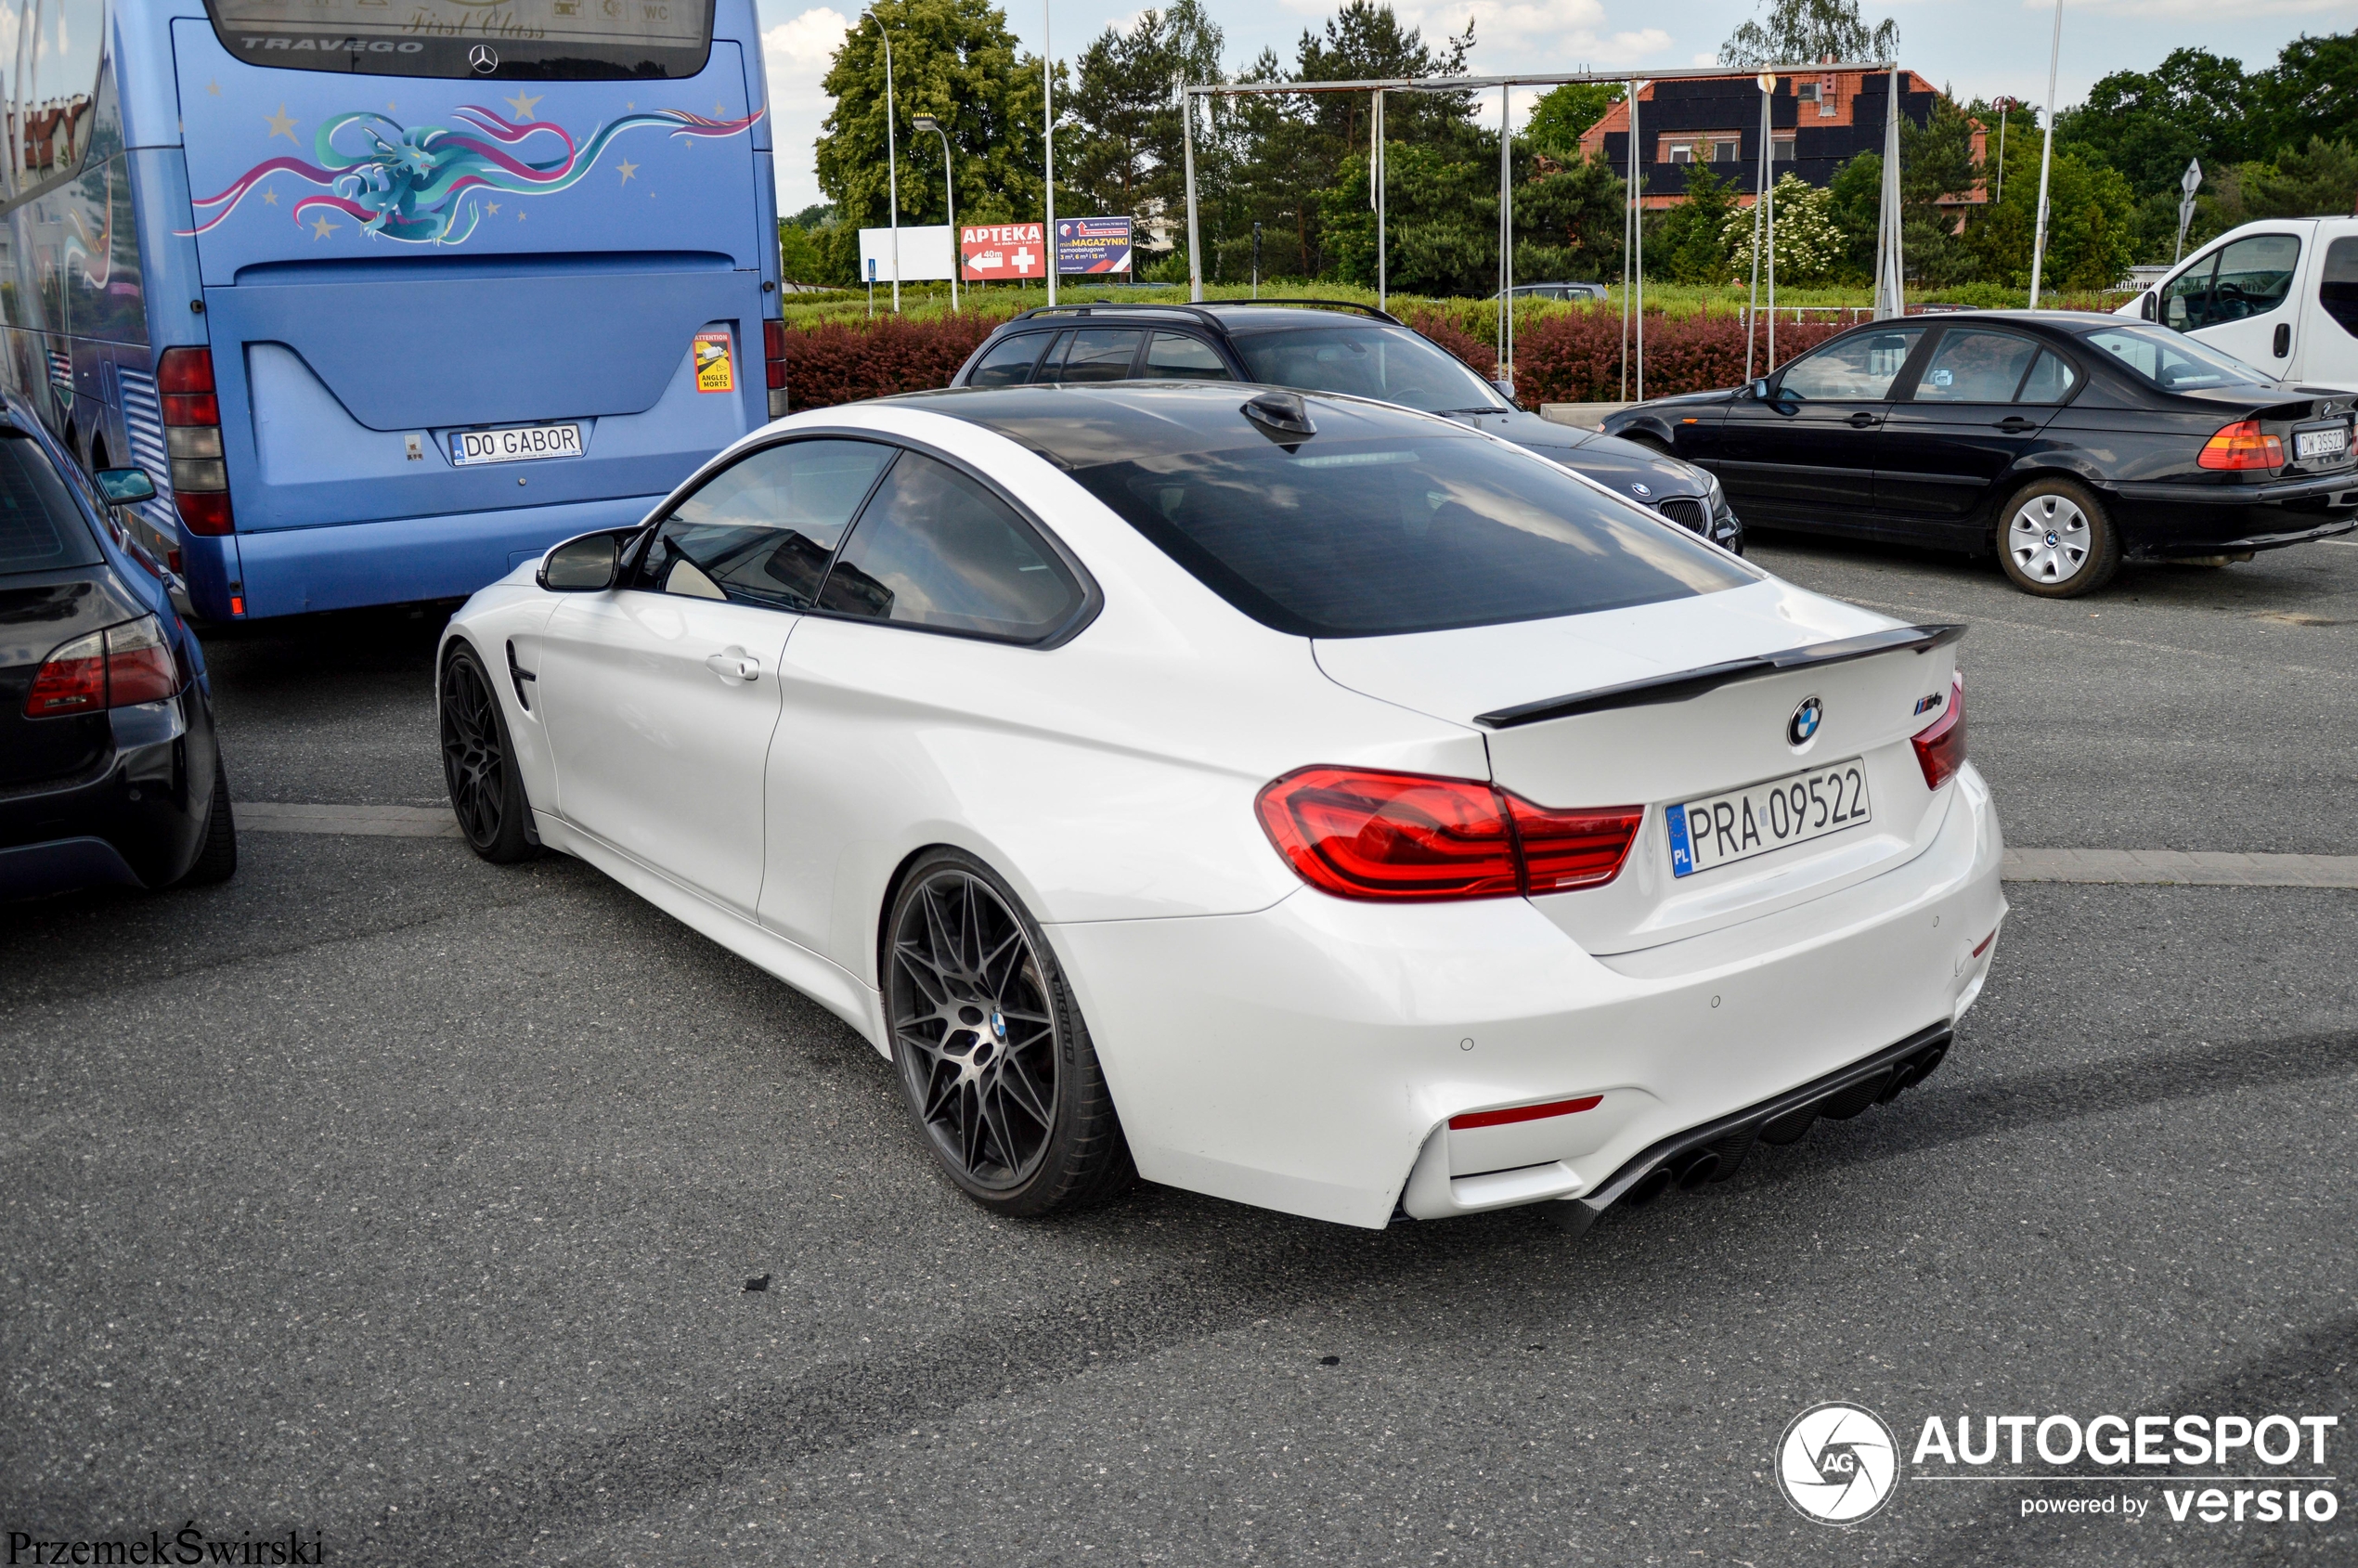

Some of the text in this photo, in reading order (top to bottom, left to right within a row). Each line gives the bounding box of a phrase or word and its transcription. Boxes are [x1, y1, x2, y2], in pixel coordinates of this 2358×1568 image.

[643, 5, 668, 20] WC
[402, 6, 545, 39] First Class
[241, 37, 424, 53] TRAVEGO
[963, 226, 1042, 243] APTEKA
[465, 434, 495, 457] DO
[503, 429, 576, 453] GABOR
[2302, 435, 2314, 454] DW
[1689, 768, 1866, 863] PRA 09522
[1675, 848, 1689, 865] PL
[1055, 982, 1074, 1061] MICHELIN
